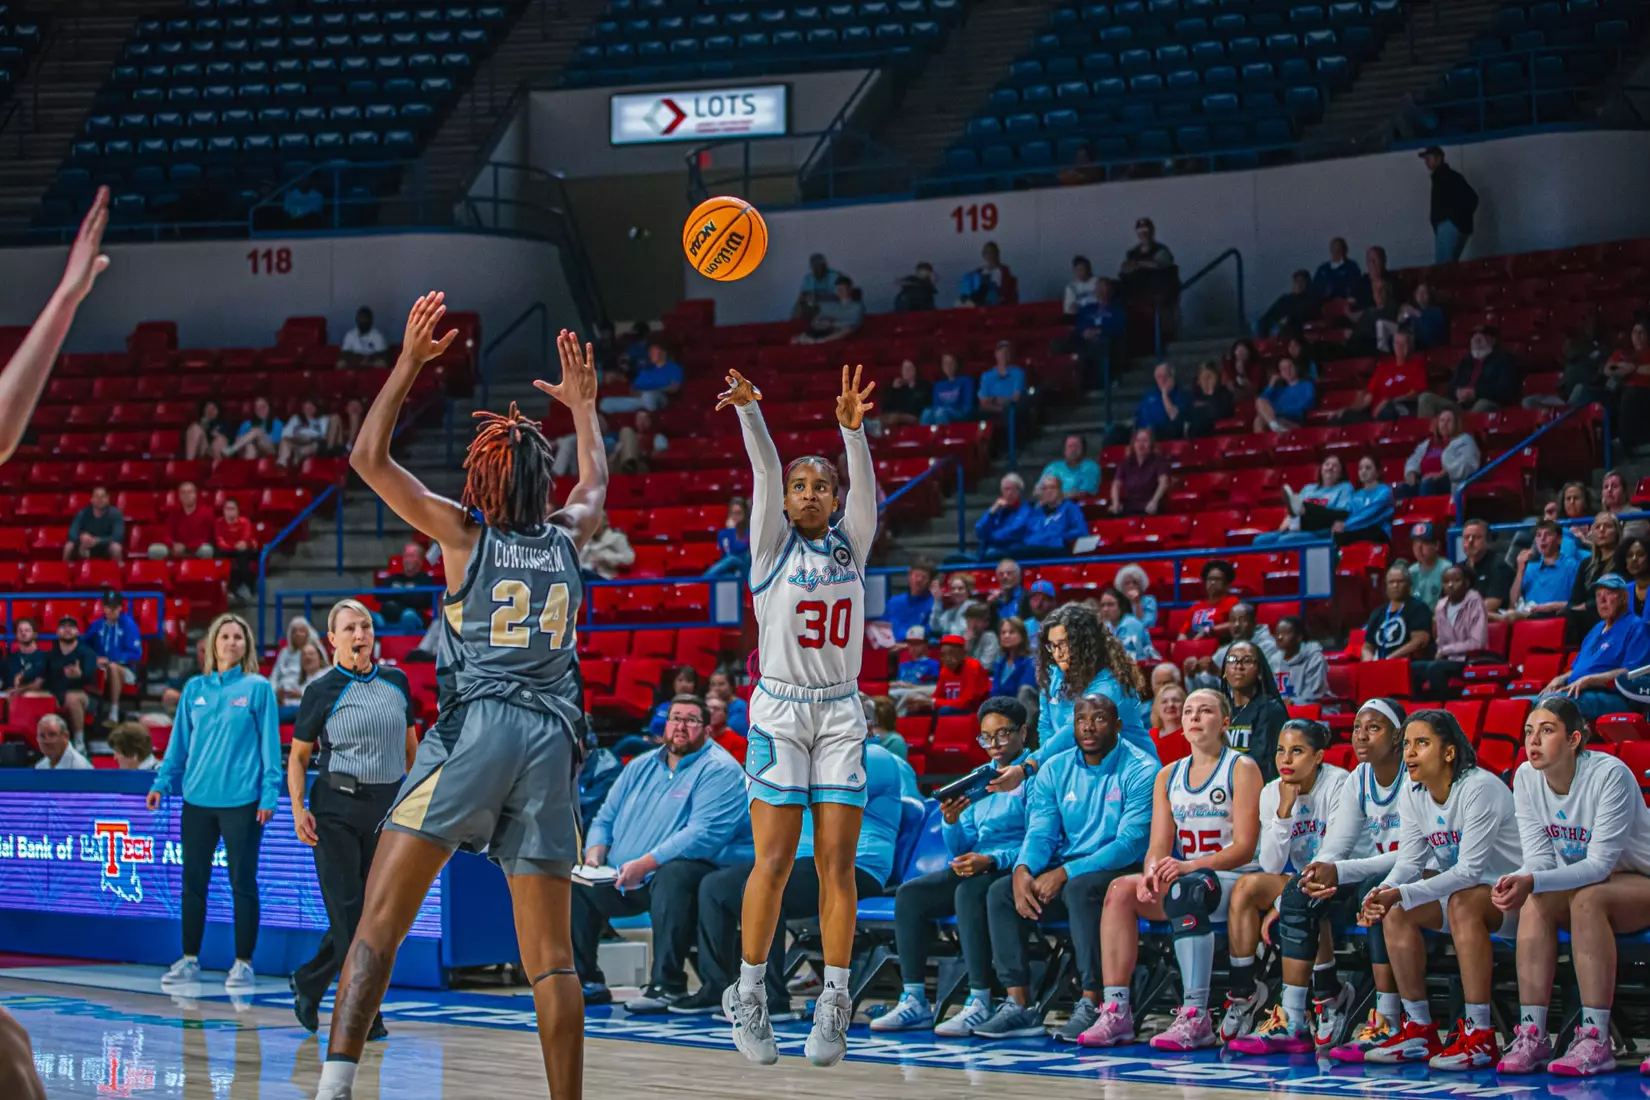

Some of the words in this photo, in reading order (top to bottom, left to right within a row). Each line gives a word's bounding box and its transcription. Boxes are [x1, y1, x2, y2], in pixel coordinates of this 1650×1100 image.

[694, 94, 756, 118] LOTS
[950, 202, 999, 234] 119
[689, 220, 717, 257] NCAA
[704, 231, 745, 275] Wilson
[246, 247, 292, 276] 118
[489, 578, 570, 650] 24
[796, 598, 852, 649] 30
[17, 834, 53, 860] Bank
[56, 834, 74, 861] of
[1178, 829, 1222, 859] 25
